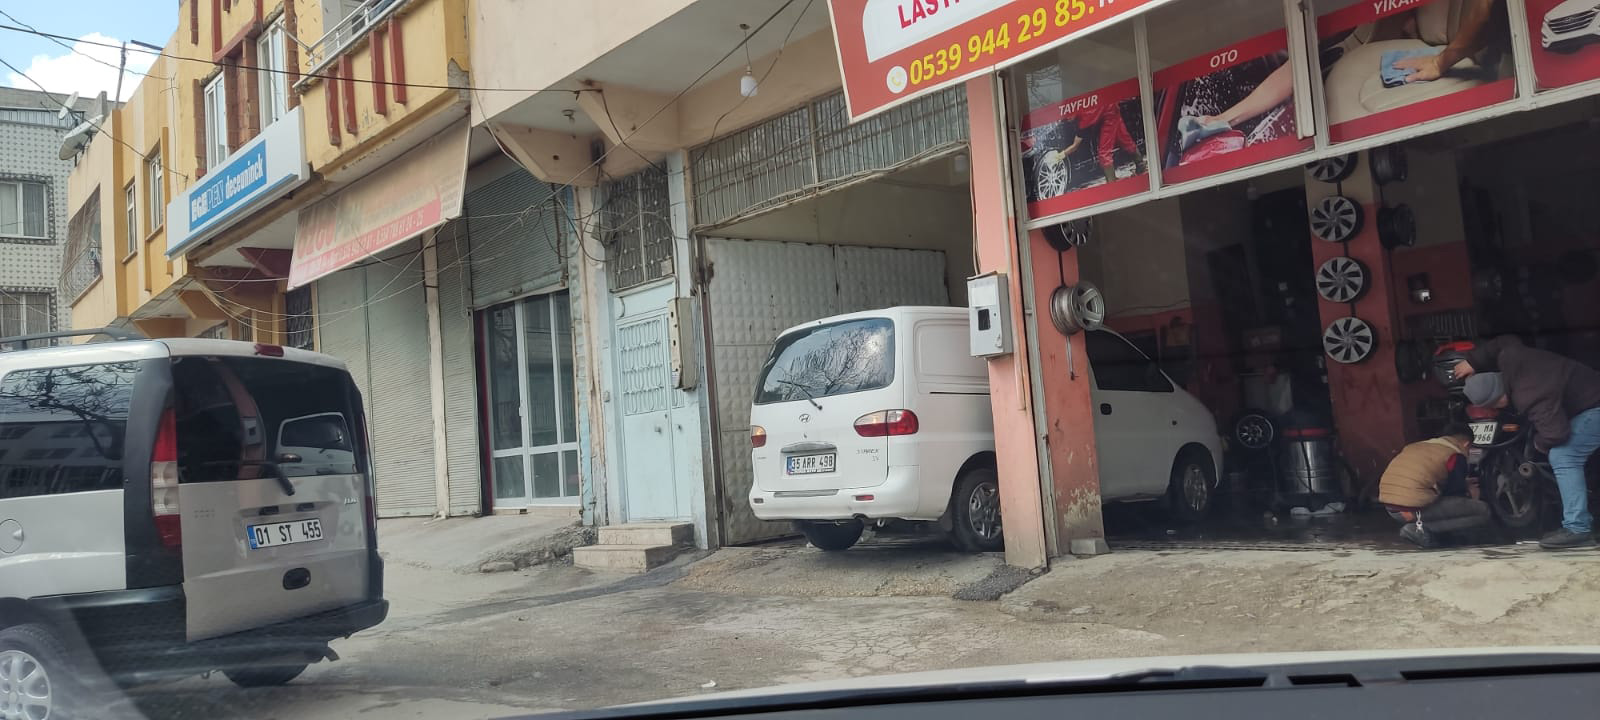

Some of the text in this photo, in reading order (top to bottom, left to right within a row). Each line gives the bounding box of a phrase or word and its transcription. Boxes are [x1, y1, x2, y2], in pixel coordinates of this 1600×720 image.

[909, 44, 962, 85] 0539
[967, 23, 1010, 63] 944
[1017, 7, 1048, 43] 29
[1210, 49, 1238, 68] OTO
[1058, 94, 1099, 117] TAYFUR
[225, 153, 264, 200] deceuninck
[791, 455, 833, 469] 35 ARR 498
[255, 520, 322, 545] 01 ST 455
